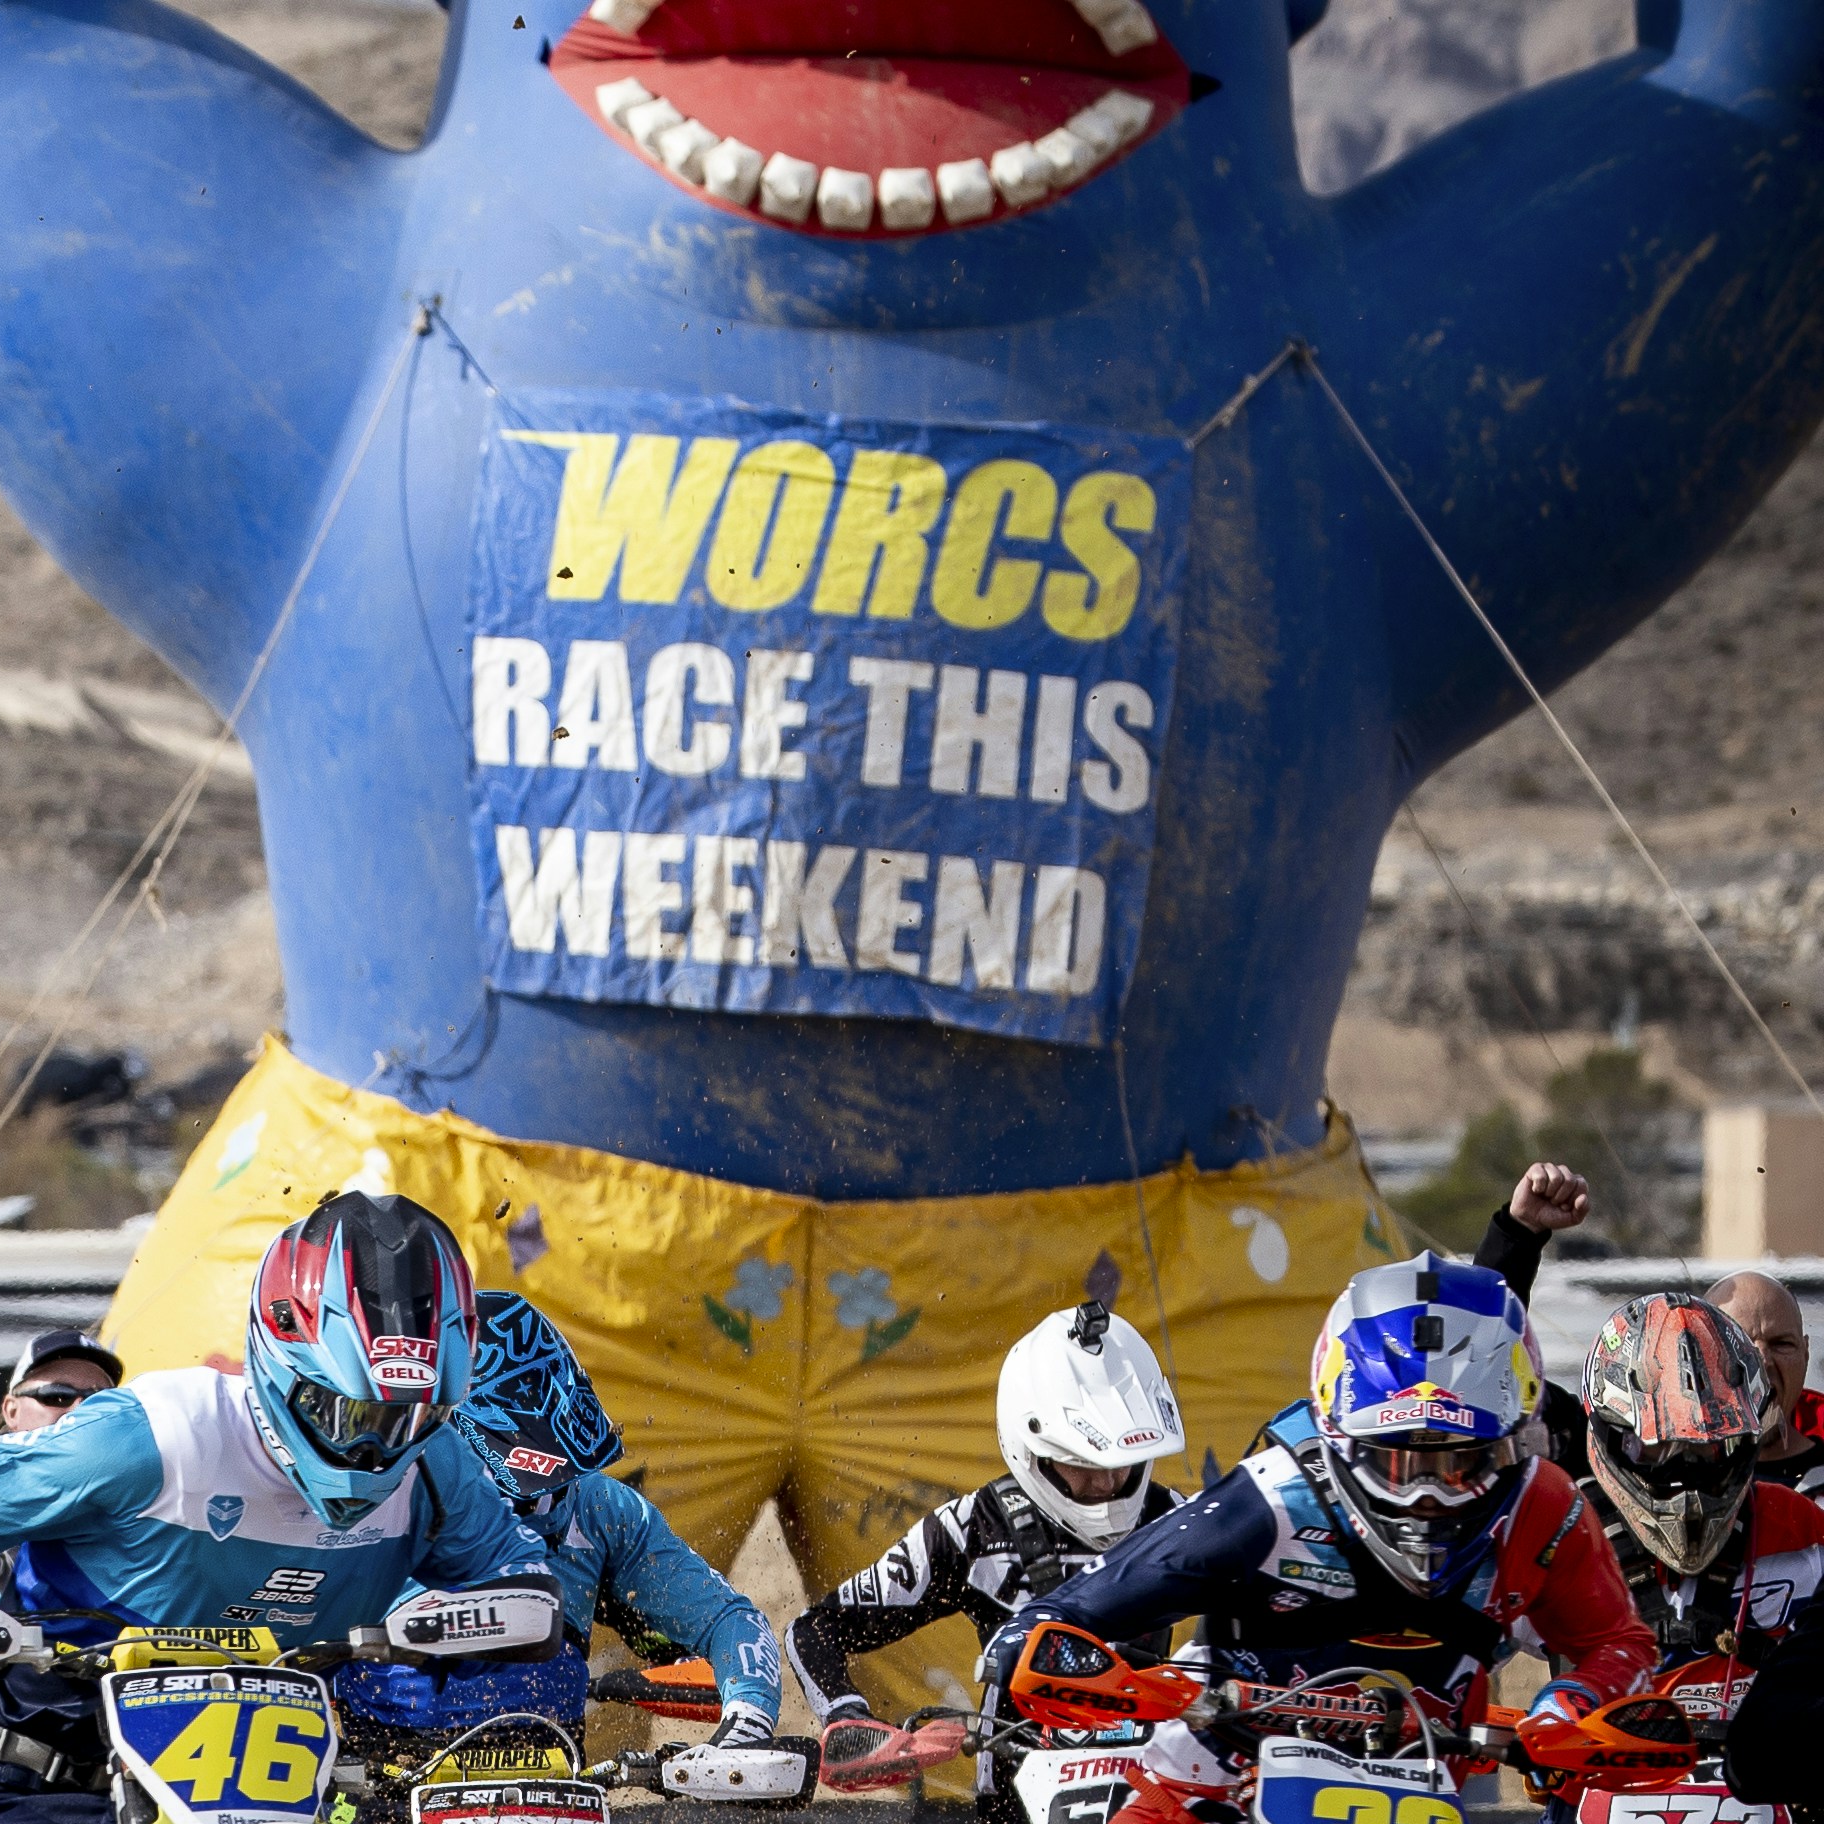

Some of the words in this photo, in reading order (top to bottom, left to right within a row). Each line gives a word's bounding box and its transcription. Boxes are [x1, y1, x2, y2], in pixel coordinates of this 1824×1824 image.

[500, 429, 1157, 641] WORCS
[473, 636, 811, 780] RACE
[850, 655, 1155, 815] THIS
[495, 825, 1107, 995] WEEKEND
[370, 1337, 437, 1359] SRT
[382, 1367, 429, 1382] BELL
[1376, 1404, 1426, 1427] Red
[1426, 1403, 1475, 1427] Bull
[1124, 1429, 1159, 1446] BELL
[505, 1447, 567, 1476] SRT
[490, 1593, 558, 1608] RACING
[223, 1606, 262, 1622] SRT
[437, 1608, 504, 1630] HELL
[152, 1627, 250, 1652] PROTAPER
[440, 1627, 506, 1641] TRAINING
[163, 1676, 209, 1690] SRT
[240, 1677, 318, 1697] SHIREY
[124, 1692, 323, 1710] worcsracing.com
[1030, 1682, 1138, 1714] ACERBIS
[1251, 1686, 1385, 1716] RENTHA
[151, 1702, 327, 1803] 46
[462, 1749, 543, 1769] PROTAPER
[1584, 1751, 1691, 1769] ACERBIS
[526, 1790, 599, 1807] WALTON
